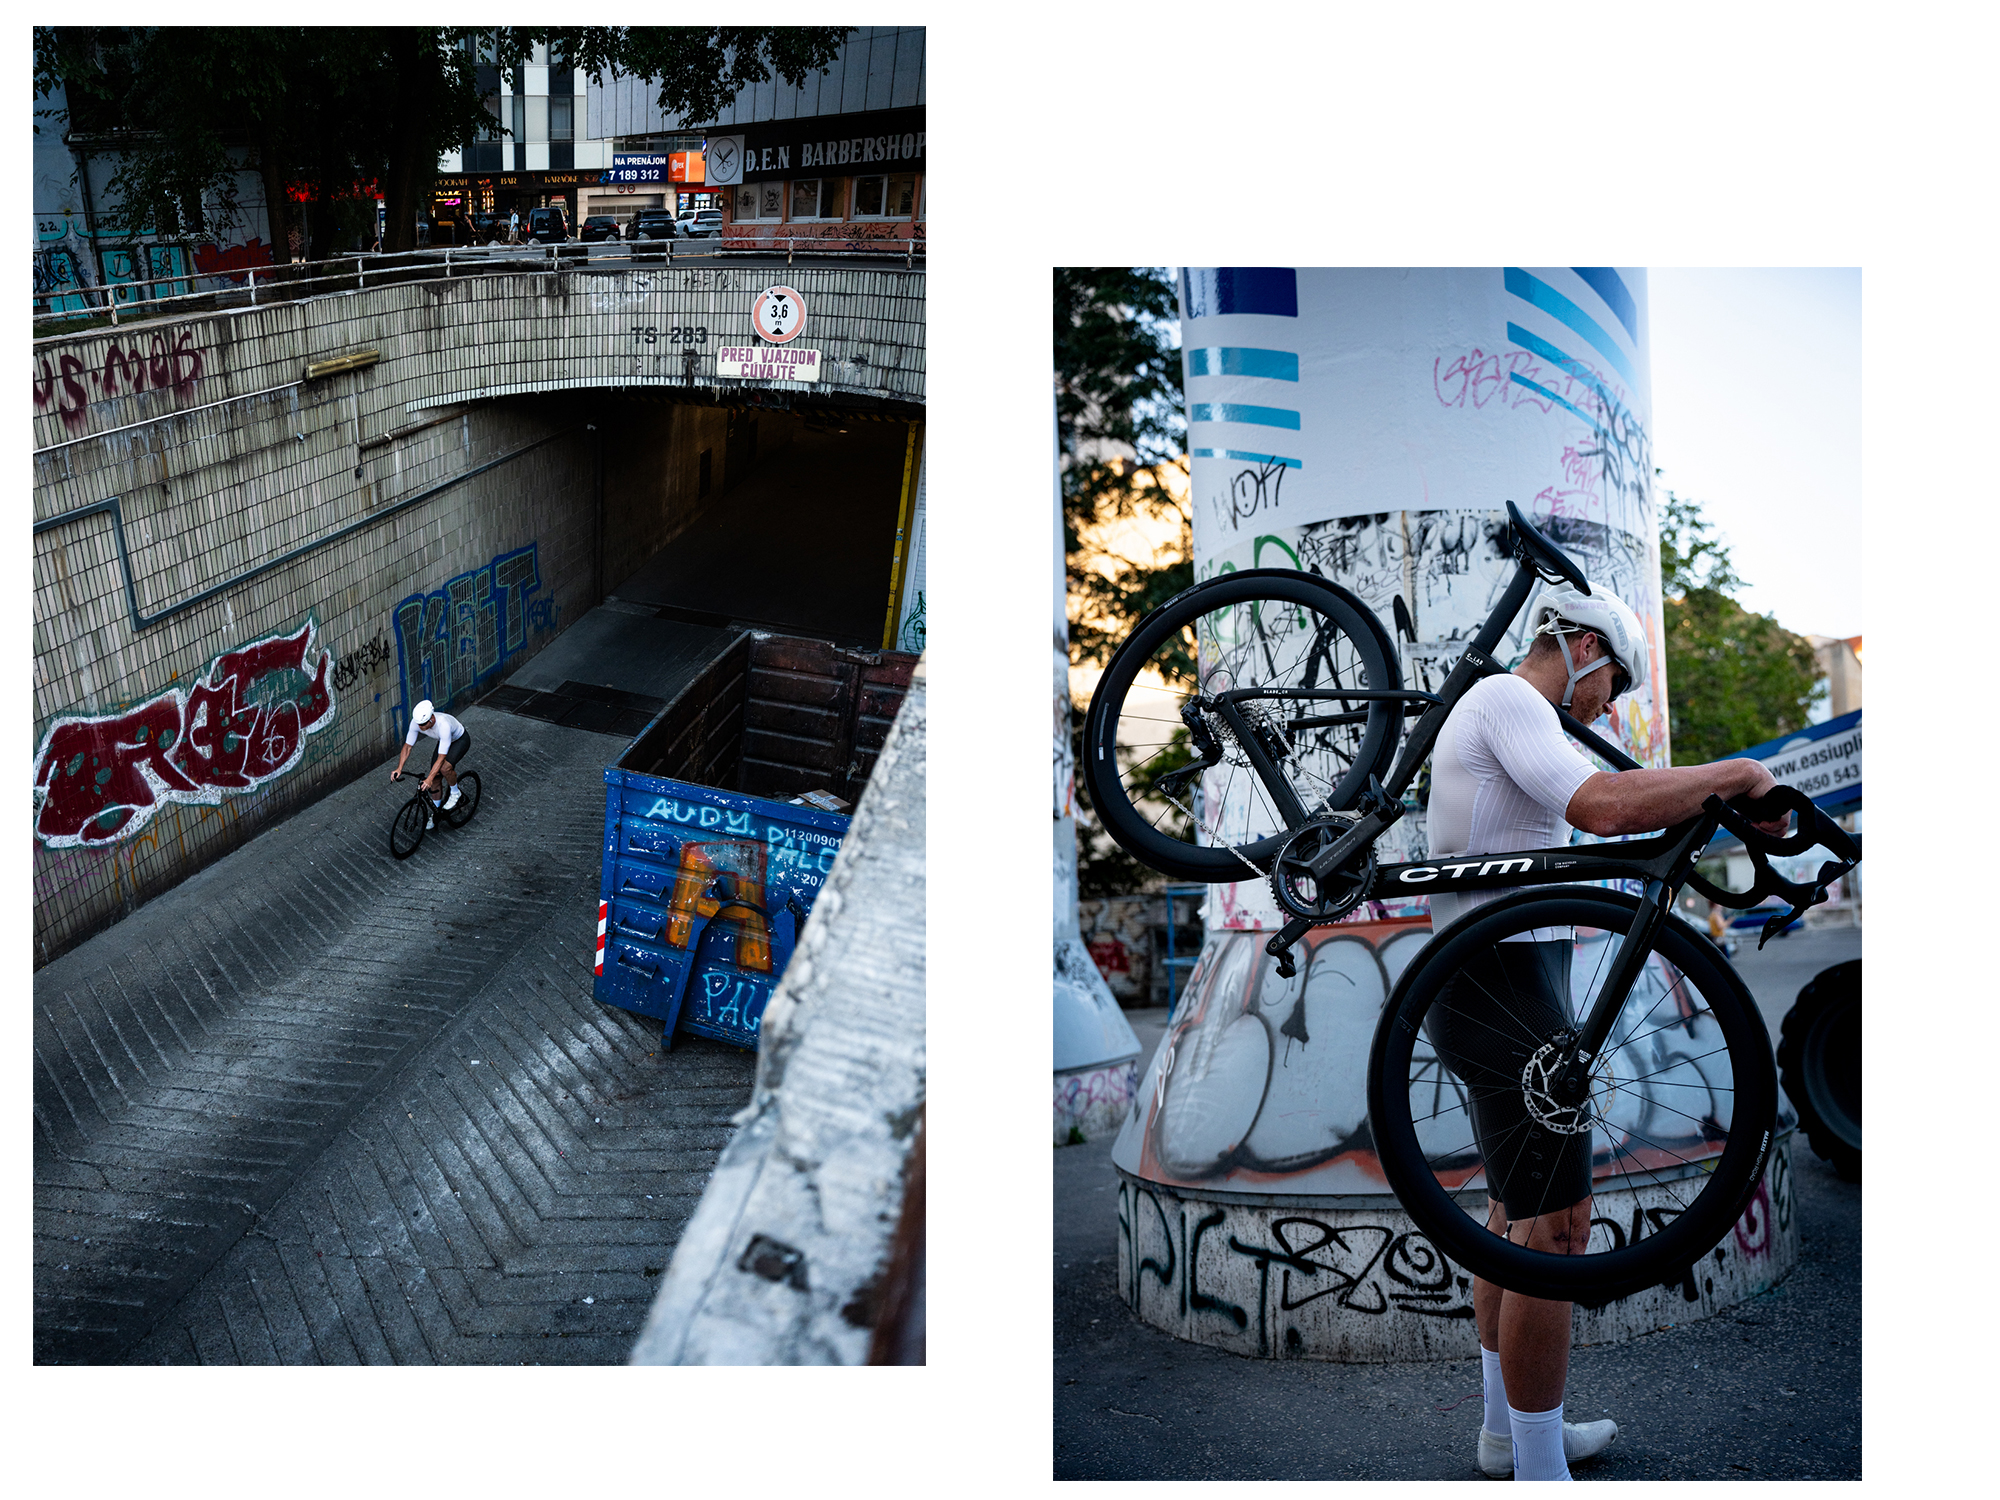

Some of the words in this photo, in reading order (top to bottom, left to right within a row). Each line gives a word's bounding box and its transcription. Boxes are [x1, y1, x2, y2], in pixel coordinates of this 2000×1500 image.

[614, 156, 625, 166] NA
[627, 155, 666, 166] PRENÁJOM
[745, 145, 790, 173] D.E.N
[801, 132, 926, 168] BARBERSHOP
[500, 177, 517, 186] BAR
[608, 170, 615, 180] 7
[619, 170, 638, 180] 189
[640, 169, 659, 180] 312
[770, 303, 789, 320] 3,6
[631, 327, 658, 344] TS
[669, 327, 707, 344] 283
[721, 347, 753, 363] PRED
[761, 349, 816, 366] VJAZDOM
[740, 361, 796, 380] CÚVAJTE
[1833, 763, 1860, 784] 543
